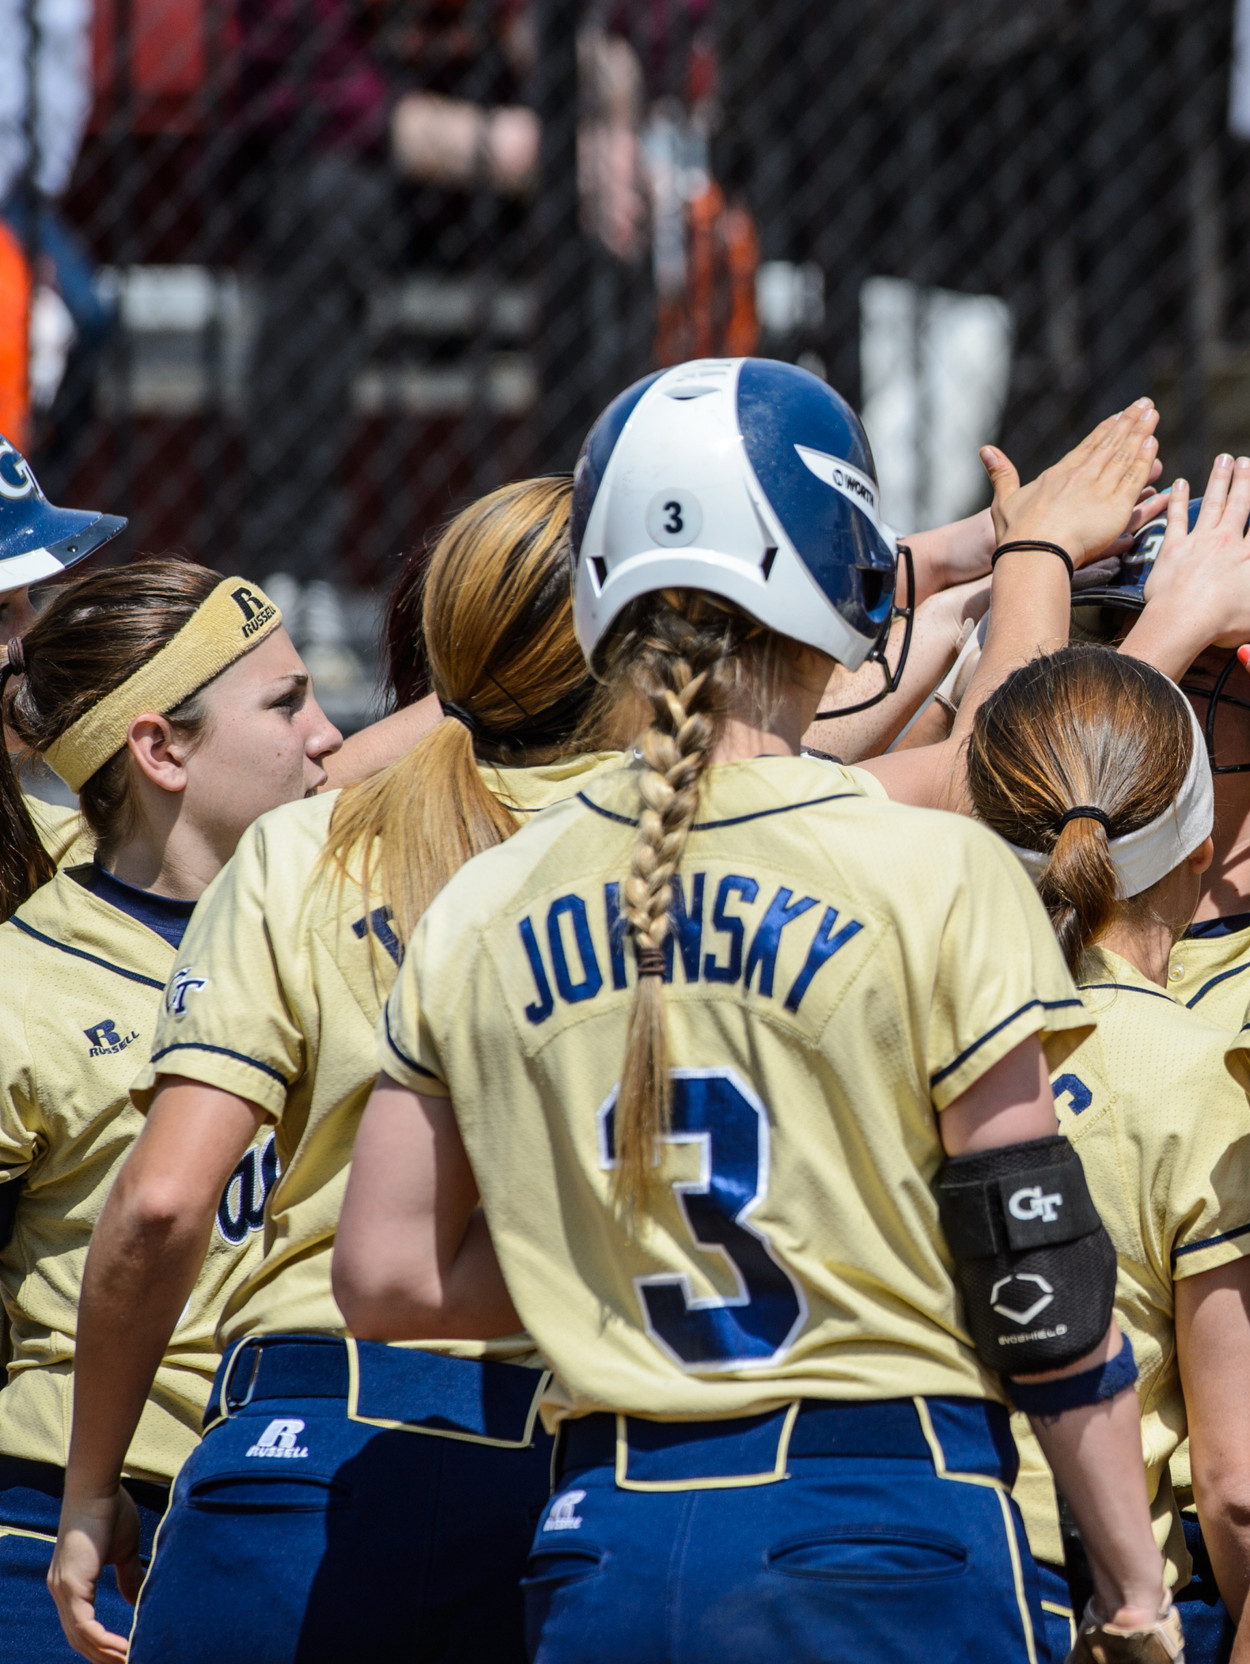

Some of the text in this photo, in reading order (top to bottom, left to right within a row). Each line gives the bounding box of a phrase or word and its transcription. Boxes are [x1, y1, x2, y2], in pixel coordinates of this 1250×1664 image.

[0, 440, 45, 500] G
[663, 501, 684, 535] 3
[242, 605, 277, 638] RUSSELL
[83, 1018, 120, 1046] R
[89, 1030, 140, 1057] RUSSELL
[596, 1066, 809, 1374] 3
[1008, 1185, 1064, 1223] GT
[256, 1418, 306, 1448] R
[245, 1444, 309, 1458] RUSSELL
